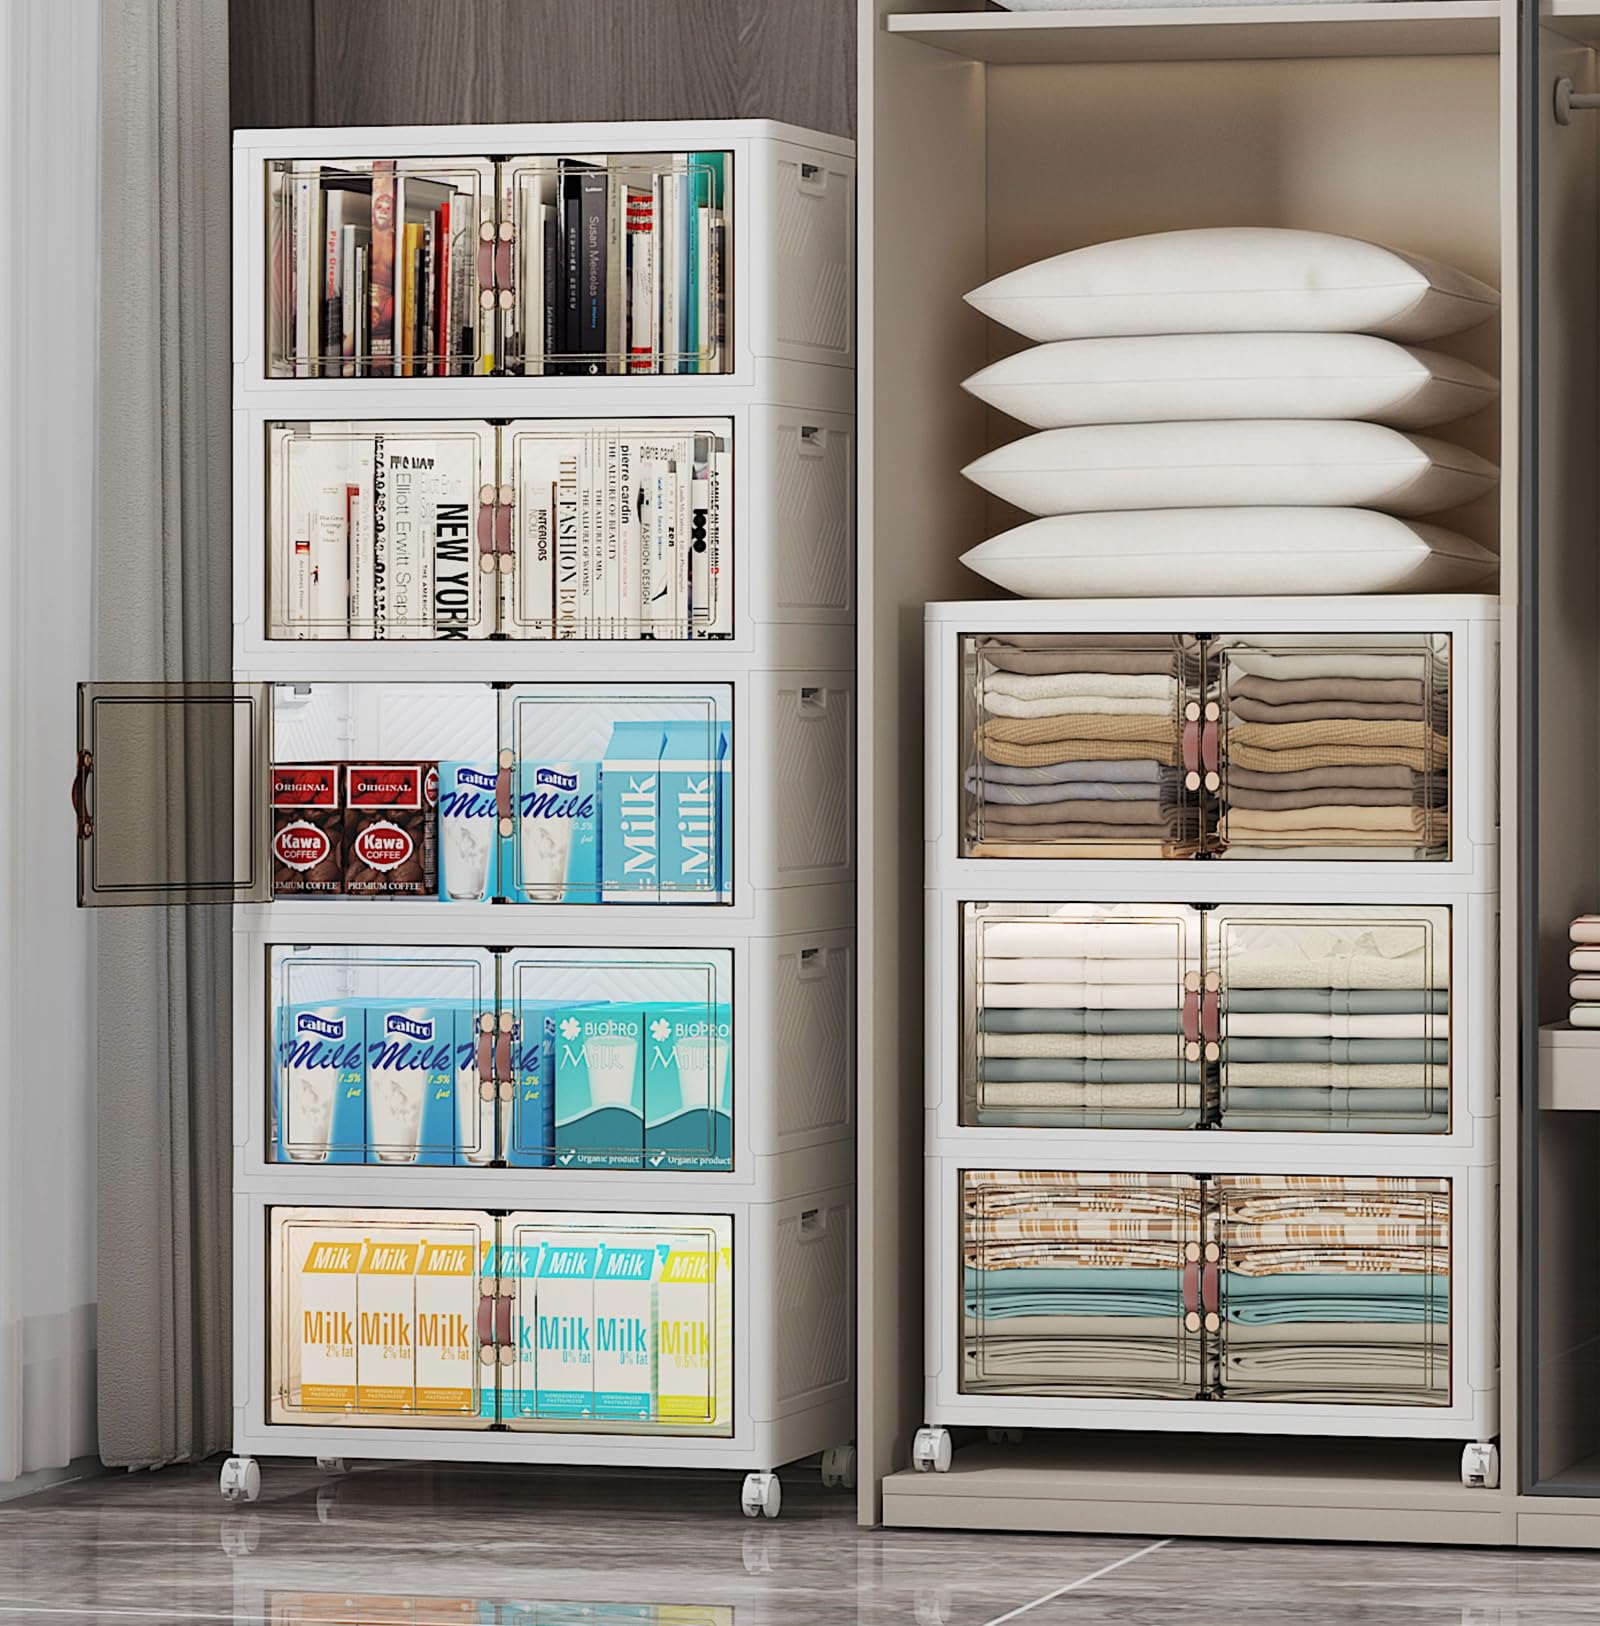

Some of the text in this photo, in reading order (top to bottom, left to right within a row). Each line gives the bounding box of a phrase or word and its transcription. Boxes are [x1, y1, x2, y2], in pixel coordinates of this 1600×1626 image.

[328, 230, 337, 254] Pipe
[588, 216, 600, 247] Susan
[608, 440, 616, 460] THE
[560, 456, 577, 496] THE
[620, 445, 632, 524] pierre cardin
[436, 503, 469, 562] NEW
[538, 509, 547, 561] INTERIORS
[560, 501, 577, 582] FASHION
[608, 520, 616, 561] BEAUTY
[393, 473, 412, 625] Elliott Erwitt Snaps
[642, 523, 650, 605] FASHION DESIGN
[436, 571, 469, 639] YORK
[275, 782, 329, 792] ORIGINAL
[357, 782, 412, 792] ORIGINAL
[440, 791, 503, 818] Mil
[520, 791, 595, 819] Milk
[620, 774, 657, 876] Milk
[677, 774, 715, 877] Milk
[282, 834, 321, 849] Kawa
[364, 834, 405, 849] Kawa
[284, 851, 318, 859] COFFEE
[366, 851, 401, 859] COFFEE
[272, 881, 338, 890] EMIUM COFFEE
[347, 881, 420, 890] PREMIUM COFFEE
[584, 1022, 639, 1036] BIOPRO
[675, 1023, 729, 1037] BIOPRO
[280, 1039, 363, 1070] Milk
[368, 1040, 451, 1071] Milk
[577, 1154, 640, 1165] Organic product
[667, 1156, 731, 1166] Organic product
[313, 1247, 352, 1269] Milk
[370, 1248, 409, 1271] Milk
[427, 1249, 467, 1272] Milk
[548, 1251, 588, 1275] Milk
[605, 1252, 645, 1276] Milk
[670, 1256, 710, 1279] Milk
[304, 1311, 353, 1344] Milk
[361, 1312, 411, 1346] Milk
[419, 1313, 469, 1347] Milk
[539, 1316, 591, 1350] Milk
[597, 1317, 647, 1352] Milk
[661, 1320, 710, 1355] Milk
[341, 1345, 353, 1357] fat
[399, 1346, 411, 1359] fat
[457, 1347, 469, 1360] fat
[578, 1350, 591, 1364] fat
[635, 1351, 649, 1365] fat
